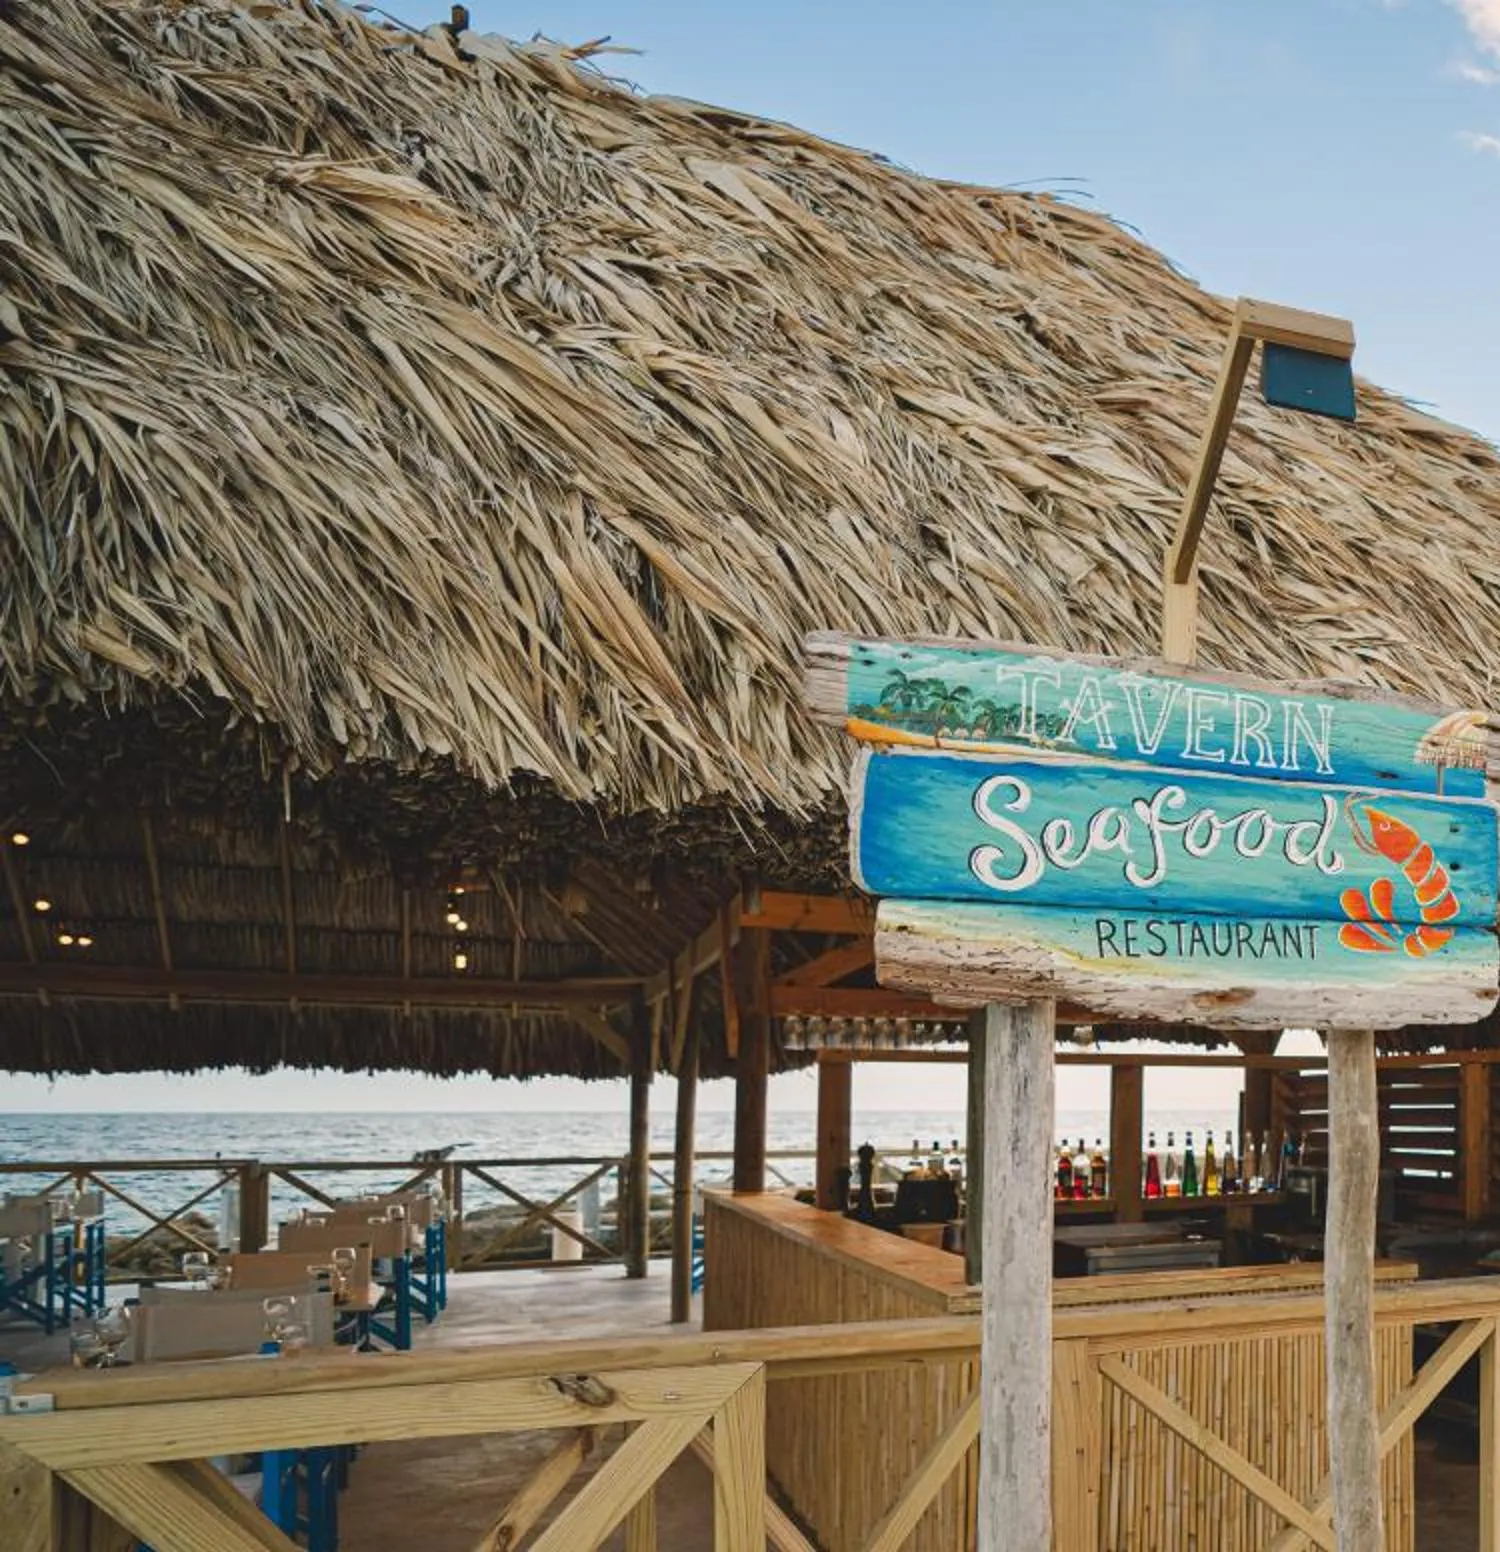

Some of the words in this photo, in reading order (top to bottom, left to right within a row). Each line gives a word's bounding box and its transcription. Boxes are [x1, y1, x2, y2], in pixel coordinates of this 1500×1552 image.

[997, 665, 1334, 774] TAVERN
[969, 775, 1344, 891] Seafood
[1096, 918, 1319, 960] RESTAURANT
